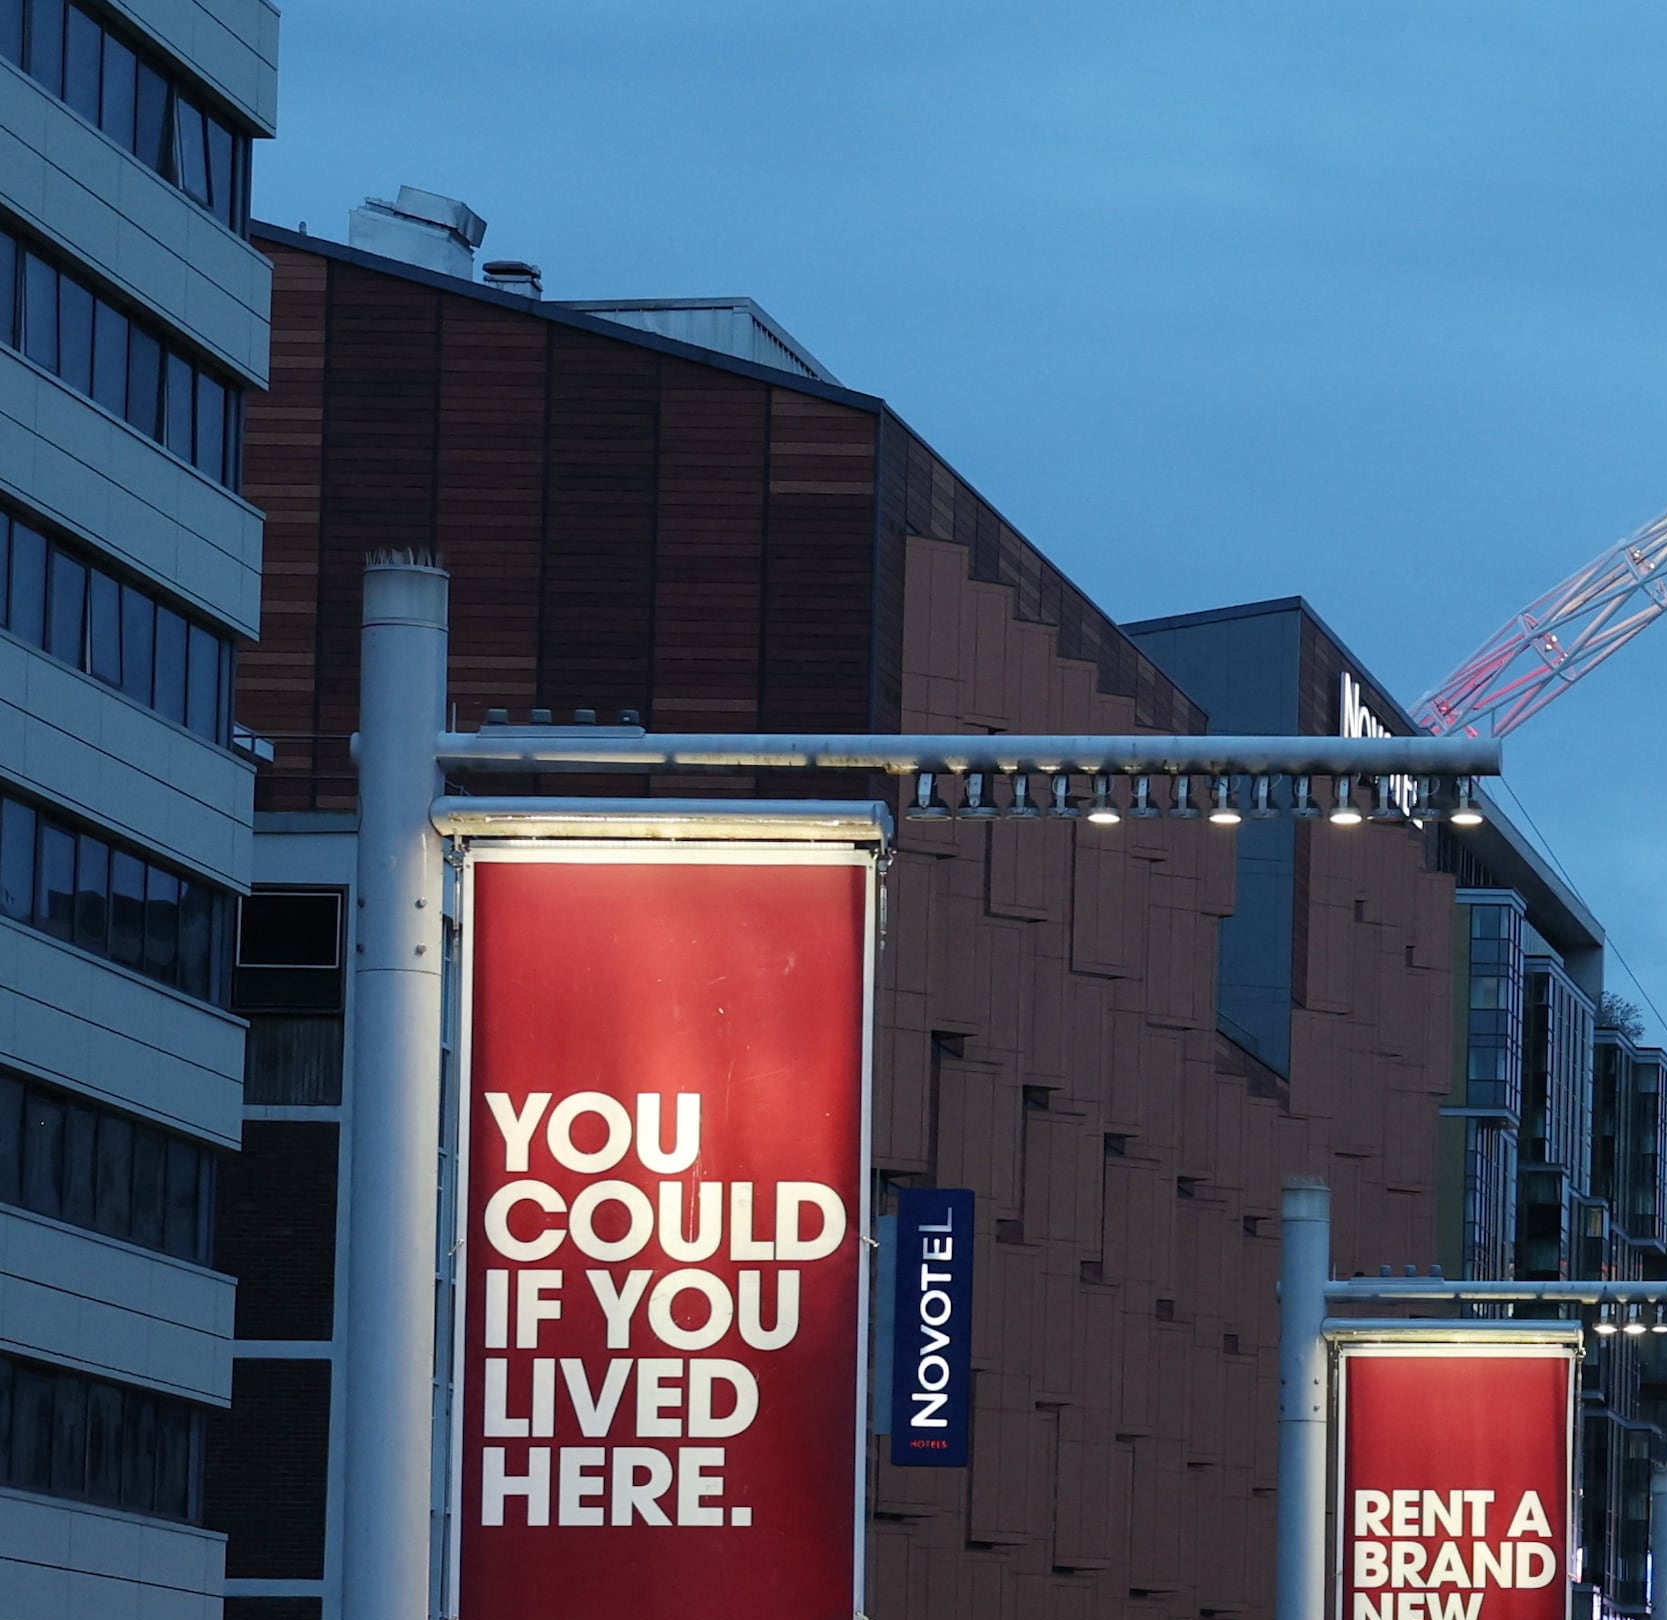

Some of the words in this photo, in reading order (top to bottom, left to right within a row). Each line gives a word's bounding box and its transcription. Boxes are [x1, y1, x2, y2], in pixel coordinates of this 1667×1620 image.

[484, 1092, 701, 1174] YOU
[484, 1179, 847, 1262] COULD
[485, 1269, 563, 1349] IF
[585, 1268, 799, 1351] YOU
[910, 1207, 953, 1428] NOVOTEL
[484, 1358, 759, 1438] LIVED
[481, 1447, 752, 1527] HERE.
[1354, 1490, 1494, 1537] RENT
[1507, 1490, 1552, 1537] A
[1353, 1541, 1556, 1589] BRAND
